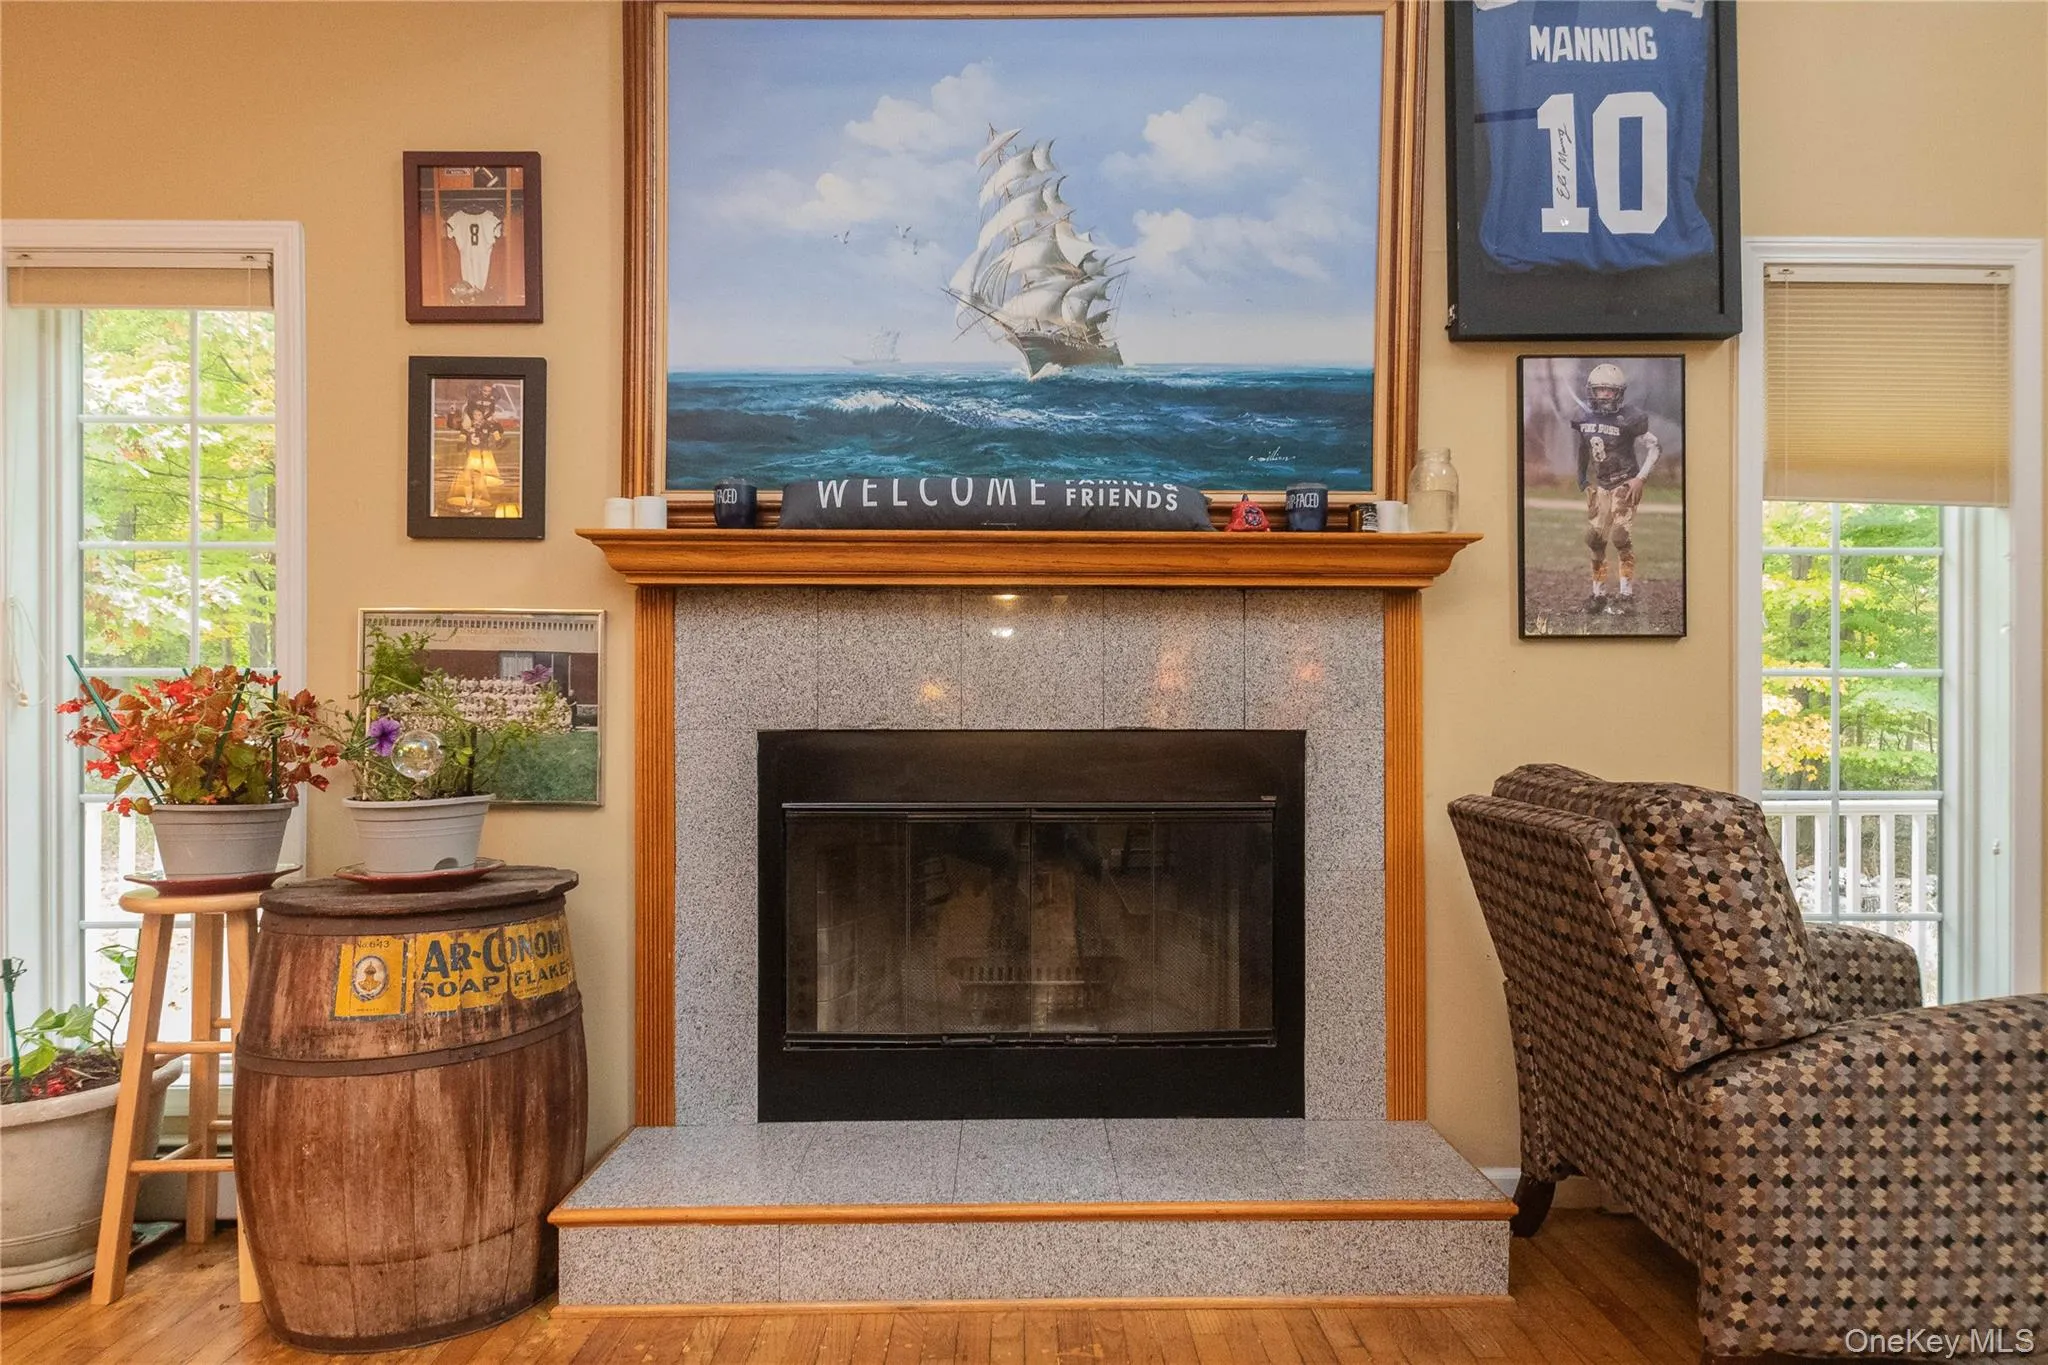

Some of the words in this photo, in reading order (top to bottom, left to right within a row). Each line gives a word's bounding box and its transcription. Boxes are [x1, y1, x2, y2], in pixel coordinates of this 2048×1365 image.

[1529, 24, 1658, 63] MANNING
[1537, 91, 1668, 235] 10
[469, 223, 480, 246] 8
[817, 477, 1046, 509] WELCOME
[1065, 488, 1178, 511] FRIENDS
[420, 975, 501, 998] SOAP
